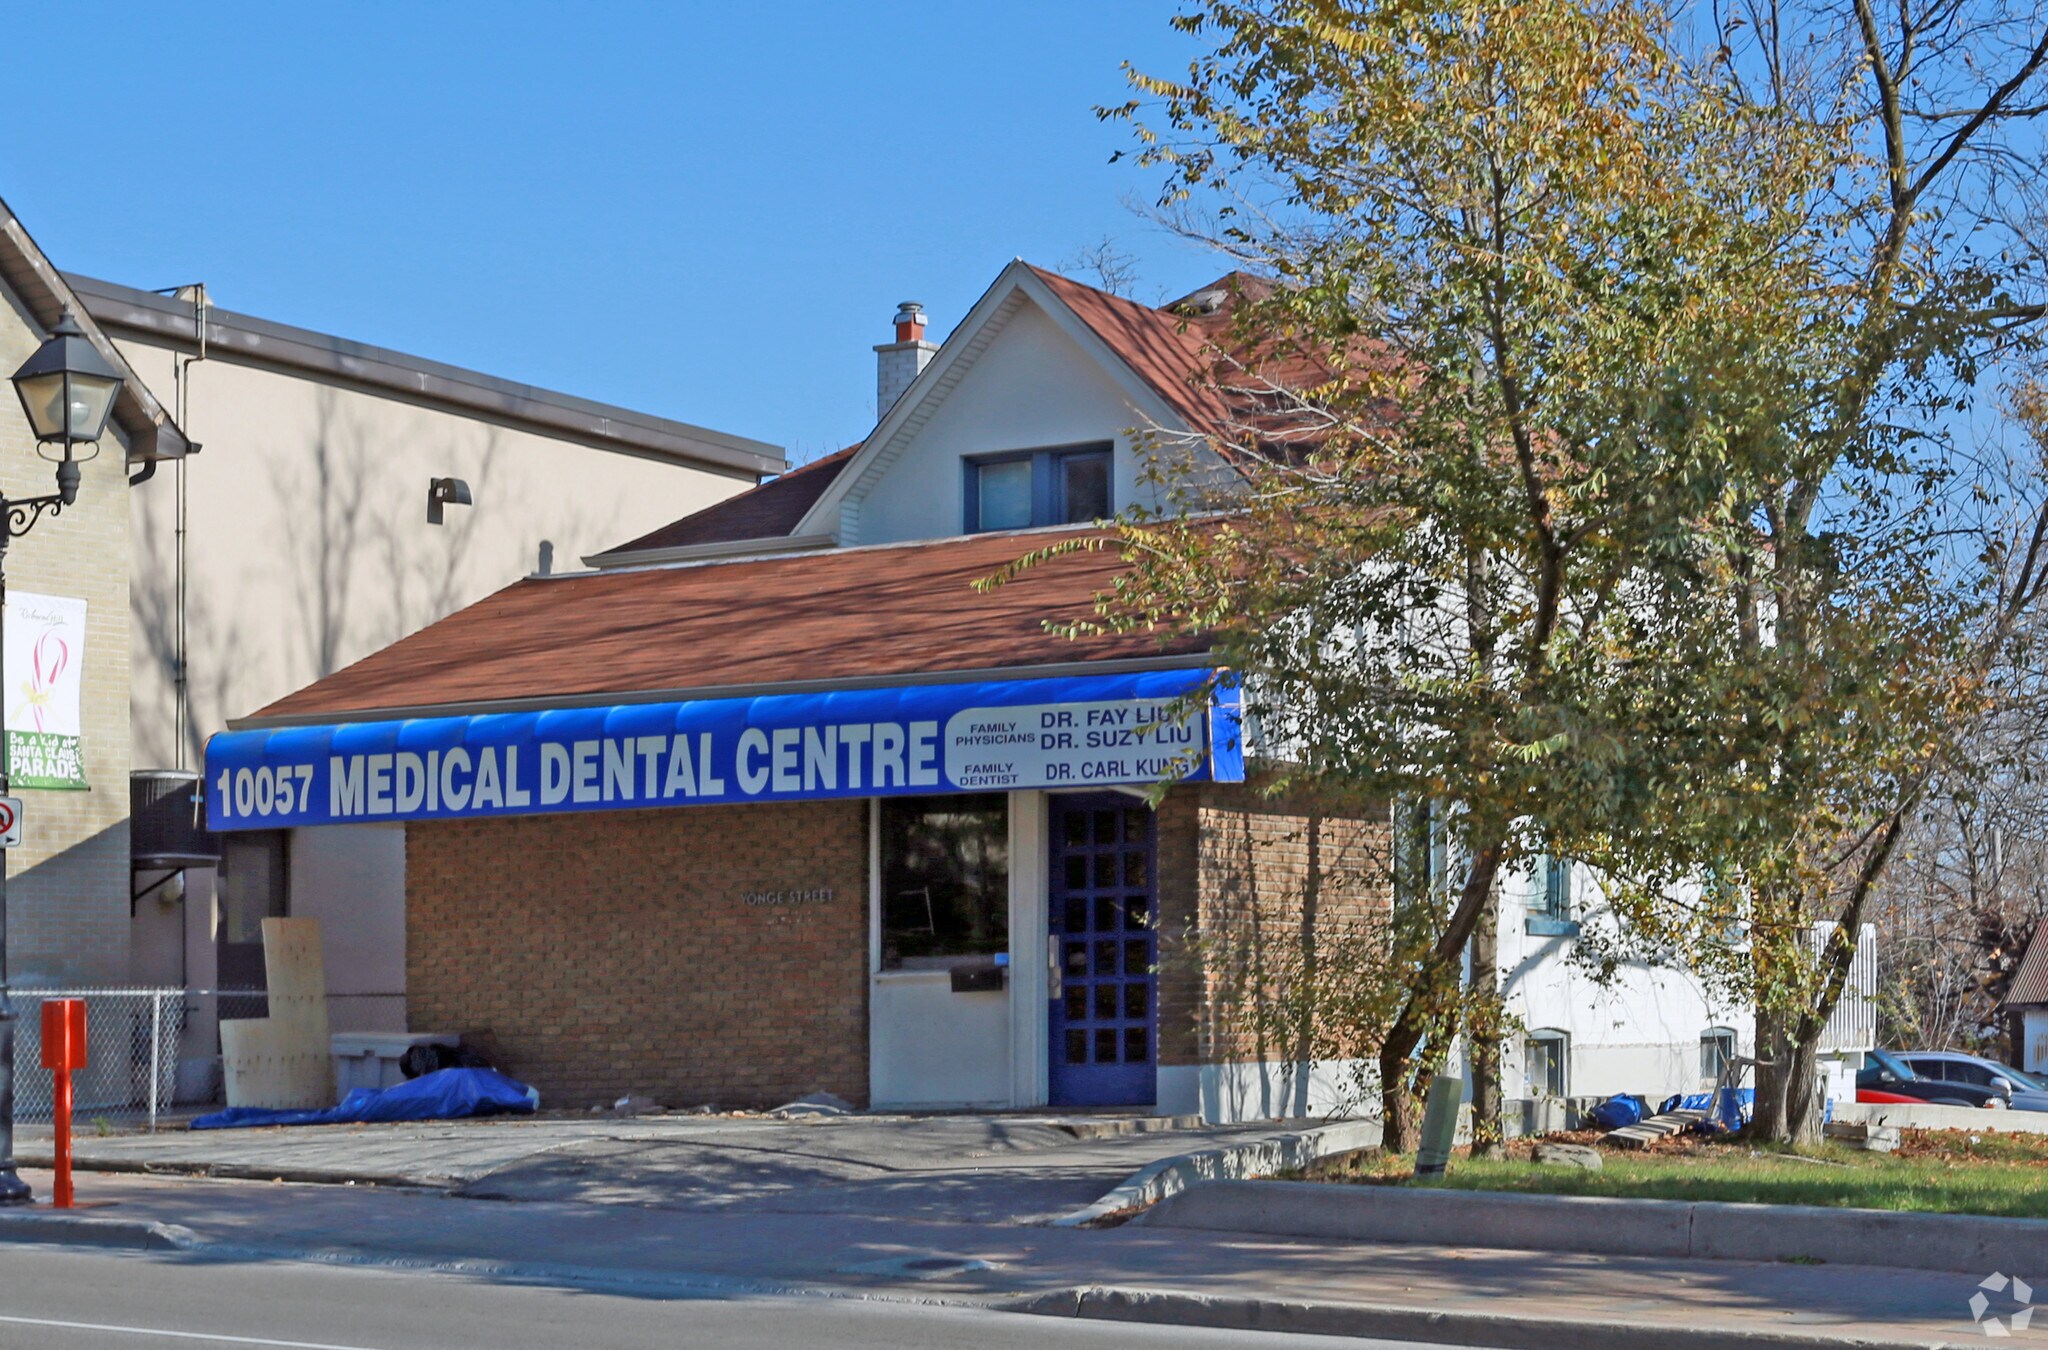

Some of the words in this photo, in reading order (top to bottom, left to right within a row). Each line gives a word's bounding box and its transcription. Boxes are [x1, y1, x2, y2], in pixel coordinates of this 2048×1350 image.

[1041, 711, 1079, 729] DR.
[1087, 708, 1129, 726] FAY
[1136, 706, 1170, 724] LIU
[970, 722, 1017, 734] FAMILY
[955, 732, 1036, 746] PHYSICIANS
[1041, 732, 1079, 750] DR.
[1086, 729, 1147, 748] SUZY
[1156, 726, 1192, 744] LIU
[9, 745, 43, 758] SANTA
[10, 756, 81, 779] PARADE
[216, 764, 314, 818] 10057
[329, 744, 531, 817] MEDICAL
[540, 732, 725, 805] DENTAL
[735, 720, 938, 796] CENTRE
[964, 762, 1014, 774] FAMILY
[1046, 763, 1076, 780] DR.
[1081, 760, 1131, 779] CARL
[960, 774, 1019, 787] DENTIST
[740, 891, 783, 906] YONGE
[789, 888, 833, 904] STREET
